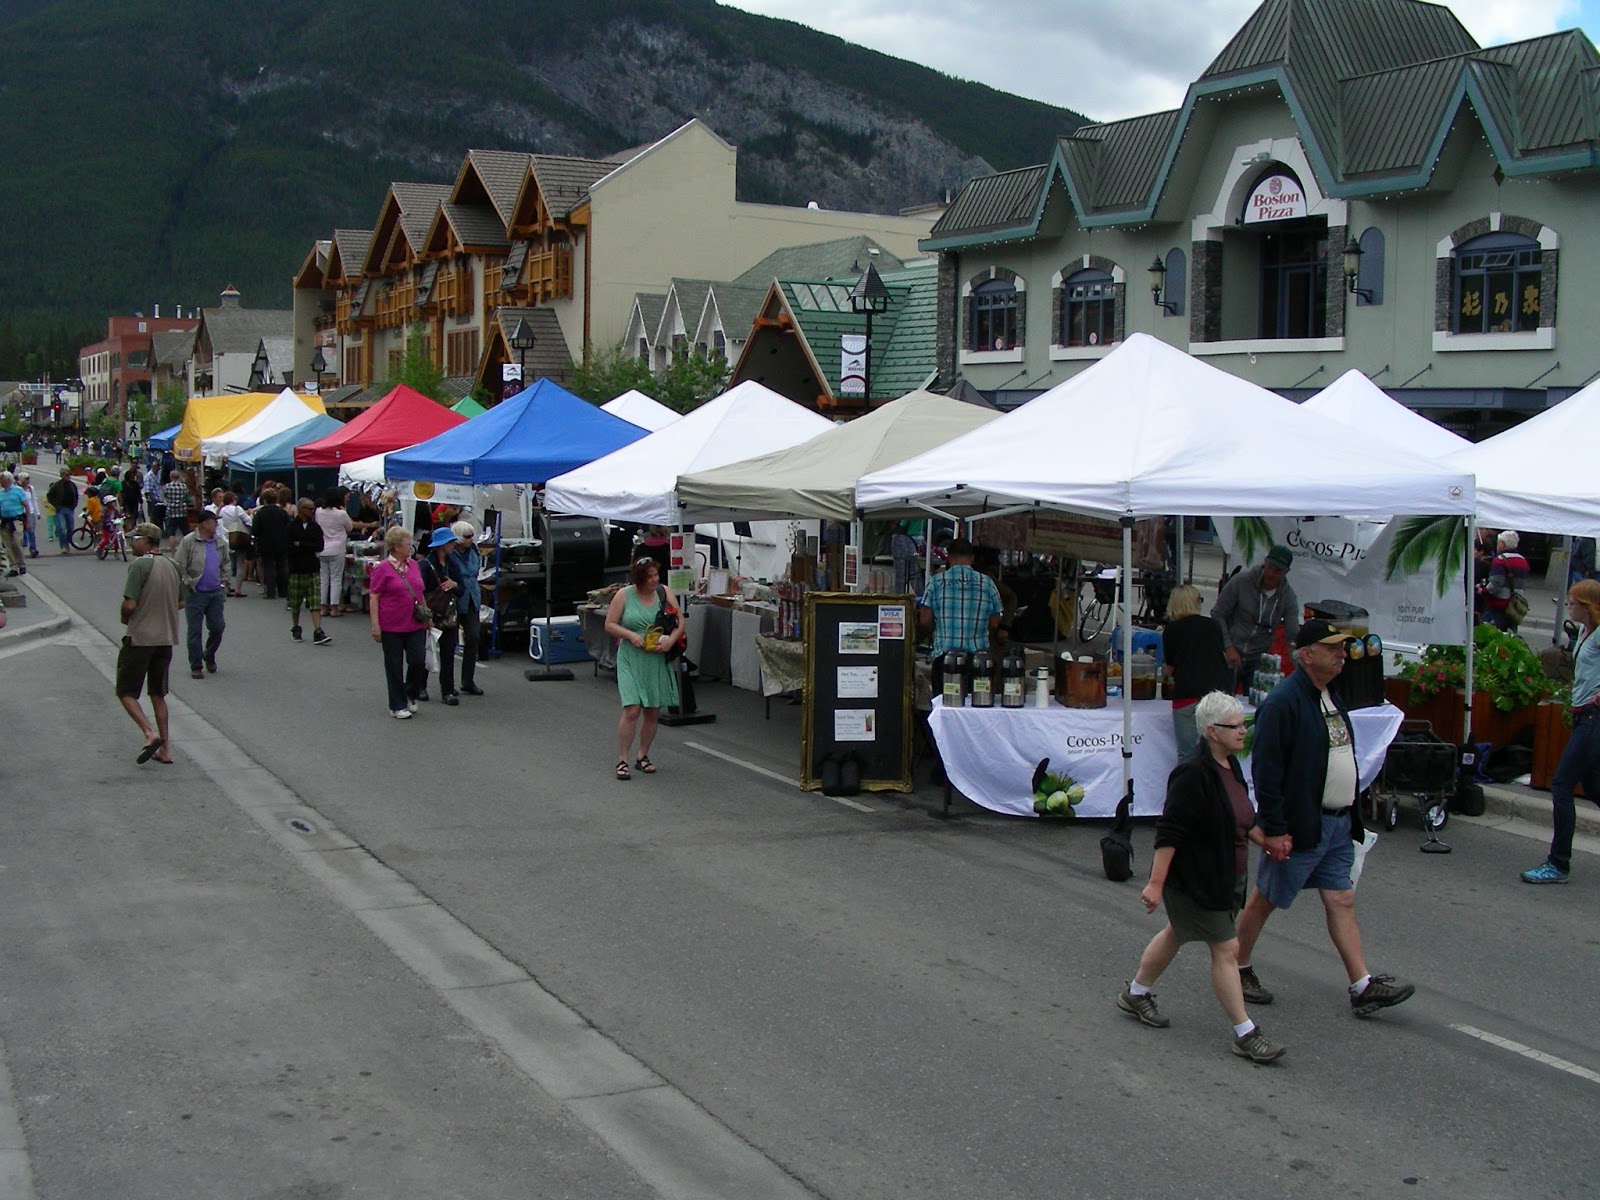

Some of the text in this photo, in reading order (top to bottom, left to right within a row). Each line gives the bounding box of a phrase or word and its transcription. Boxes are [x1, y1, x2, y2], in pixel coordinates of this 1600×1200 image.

[1253, 192, 1300, 207] Boston
[1258, 206, 1293, 220] Pizza
[1411, 606, 1425, 614] PURE
